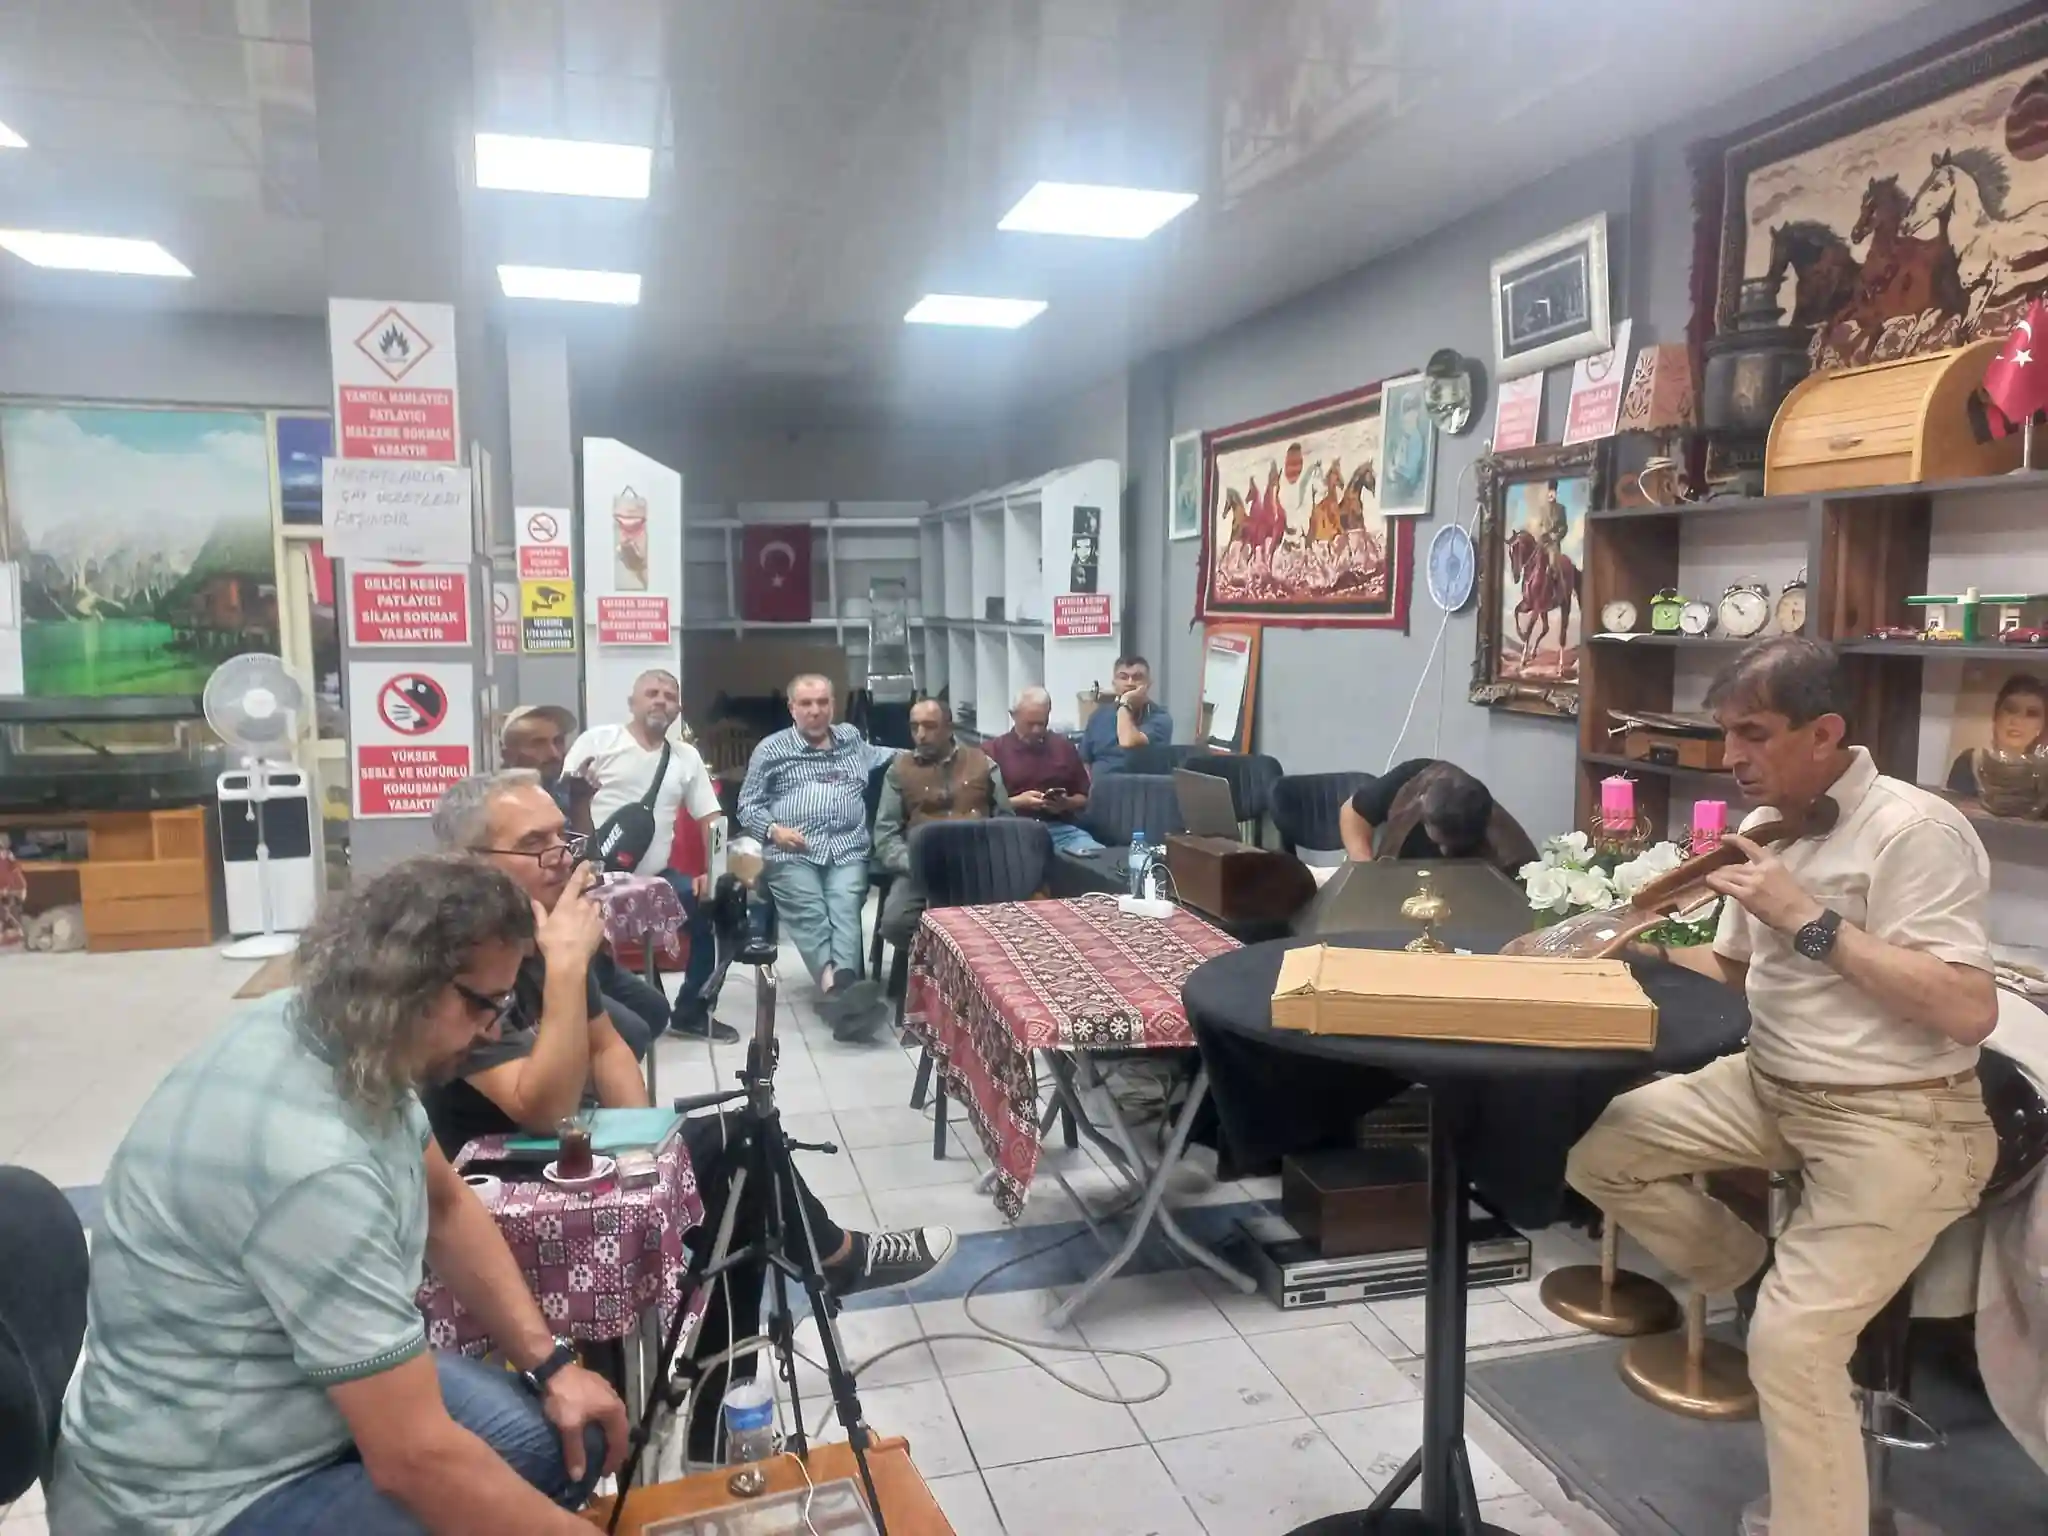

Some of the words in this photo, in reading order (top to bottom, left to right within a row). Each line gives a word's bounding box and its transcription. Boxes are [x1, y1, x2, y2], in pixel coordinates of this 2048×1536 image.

[376, 593, 443, 608] PATLAYICI
[362, 609, 400, 624] SİLAH
[403, 611, 459, 625] SOKMAK
[379, 627, 444, 640] YASAKTIR
[391, 749, 438, 764] YÜKSEK
[398, 767, 414, 779] VE
[416, 764, 467, 778] KÜFÜRLÜ
[388, 799, 438, 812] YASAKTI
